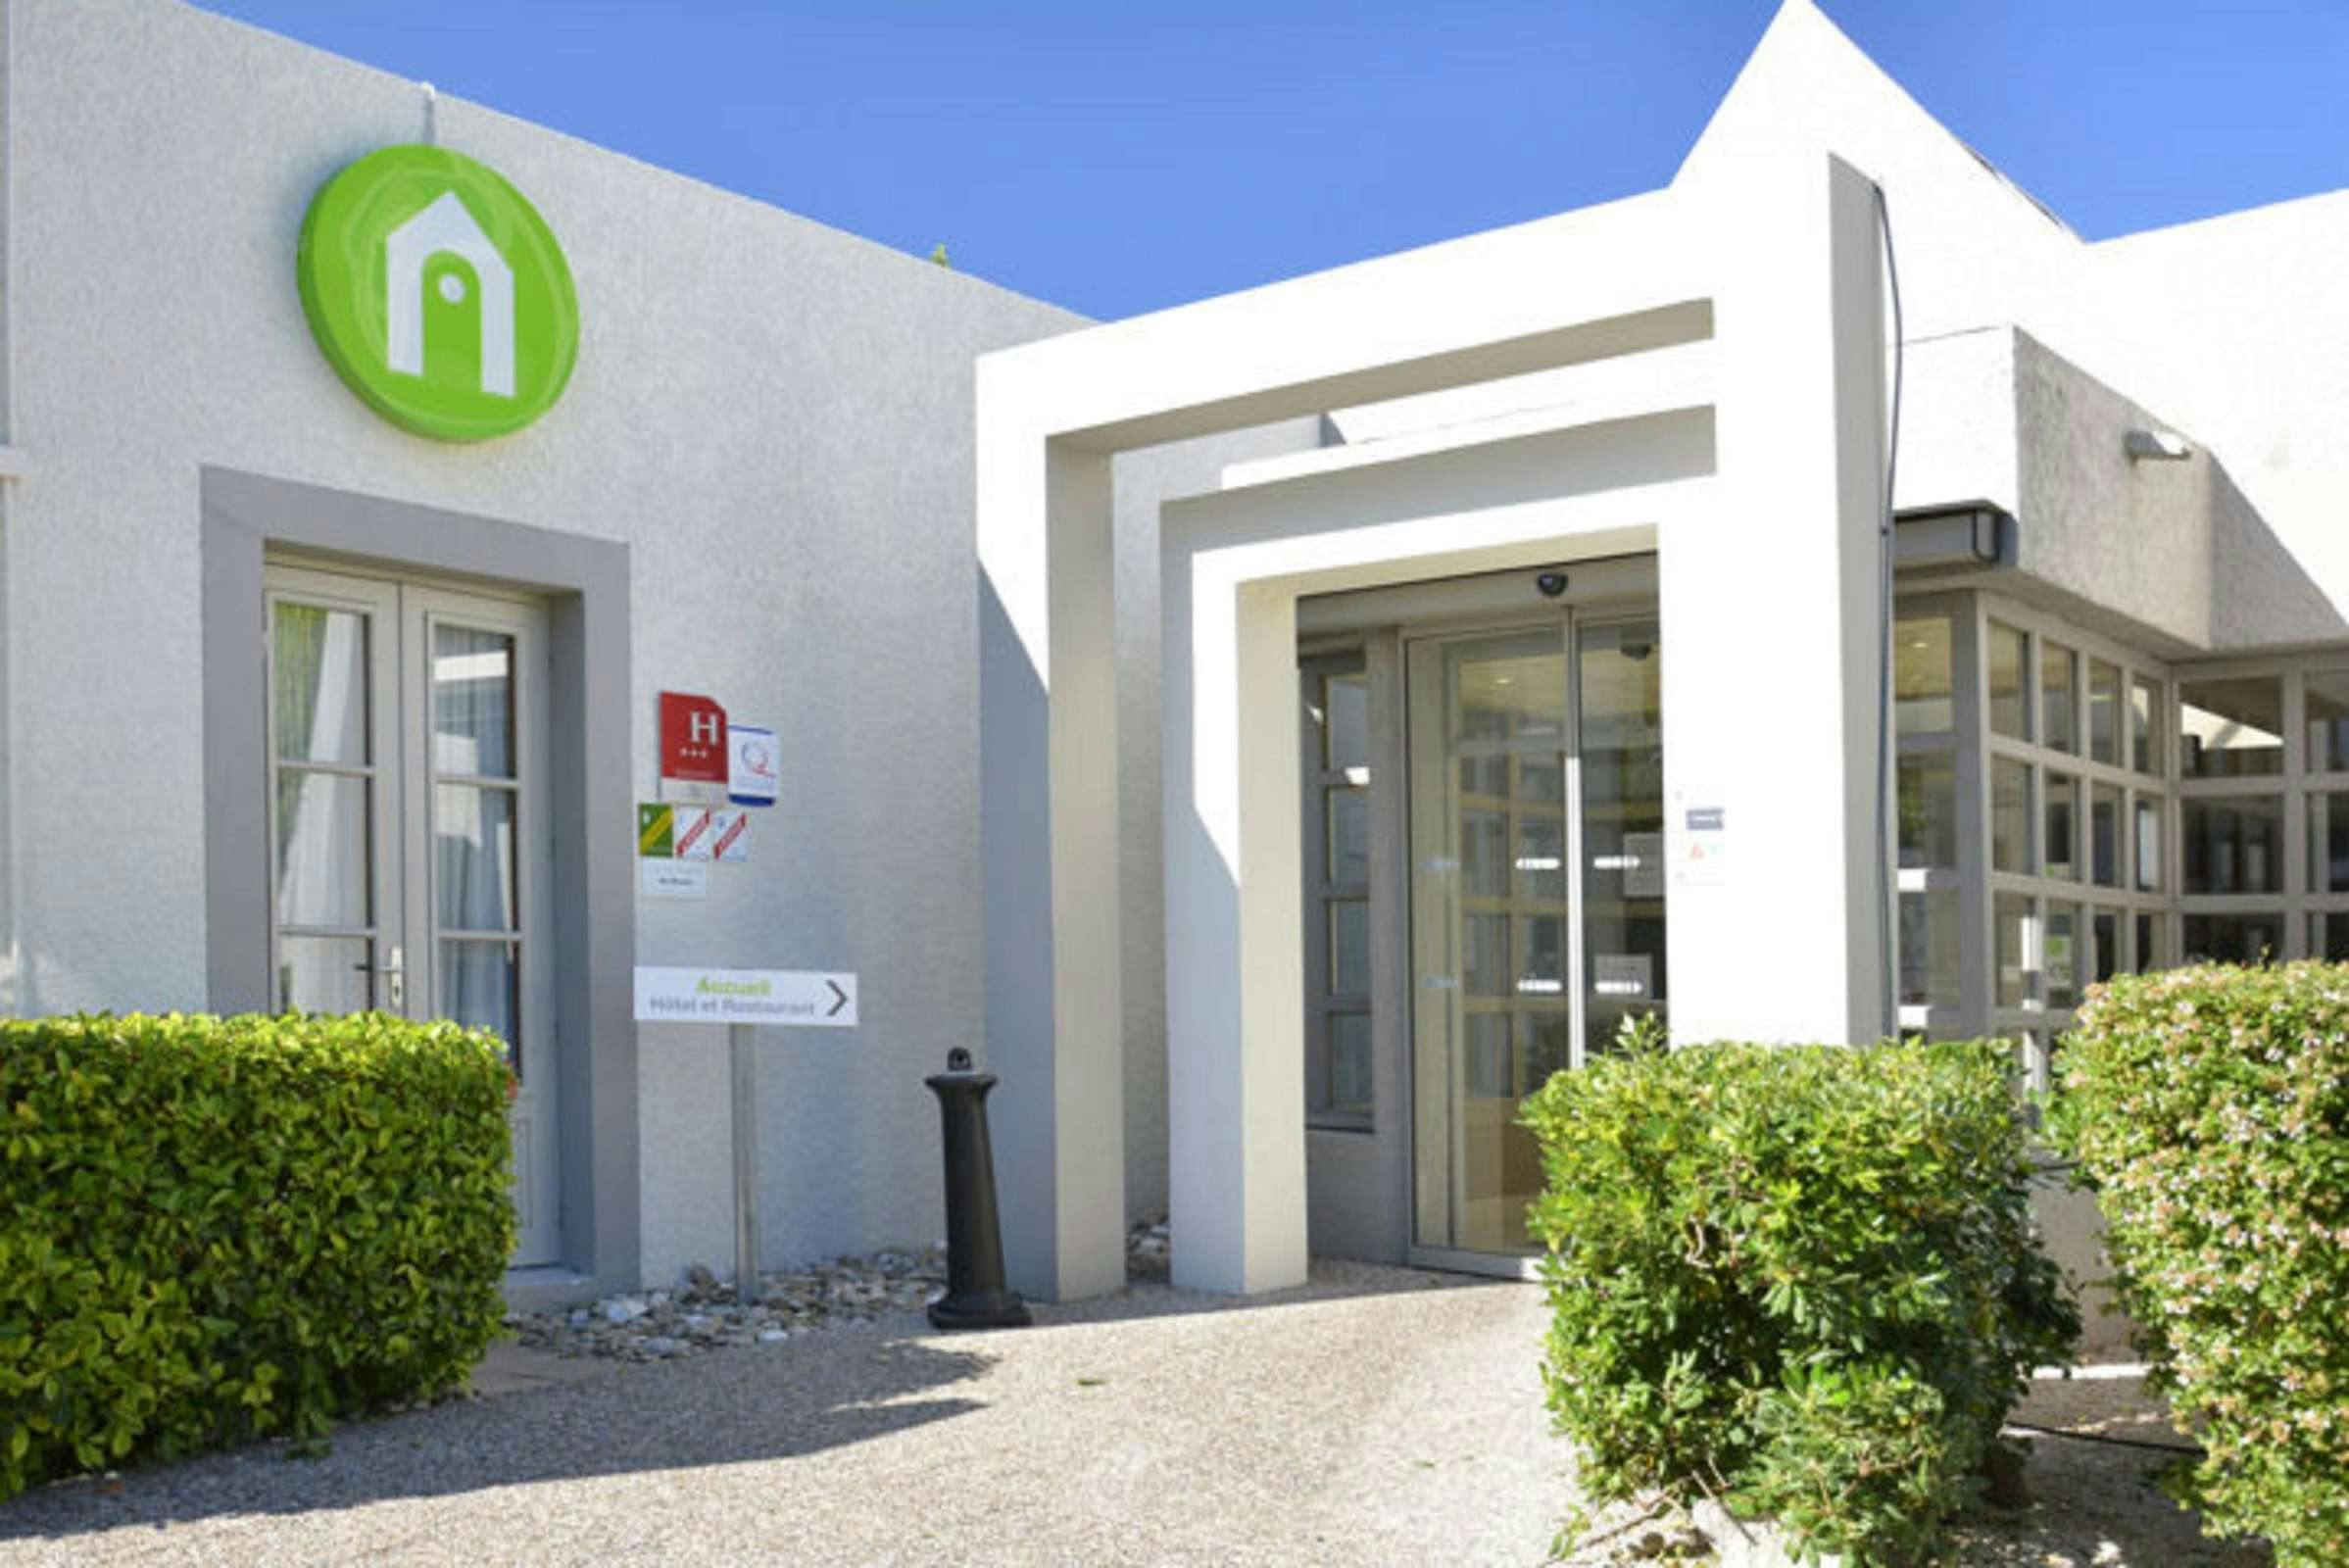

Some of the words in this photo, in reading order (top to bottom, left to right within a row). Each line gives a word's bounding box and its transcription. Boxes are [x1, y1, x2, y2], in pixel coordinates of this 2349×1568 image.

[690, 712, 718, 745] H
[697, 976, 771, 995] Accueil
[650, 997, 696, 1013] Hôtel
[701, 999, 717, 1014] et
[722, 1000, 814, 1016] Restaurant
